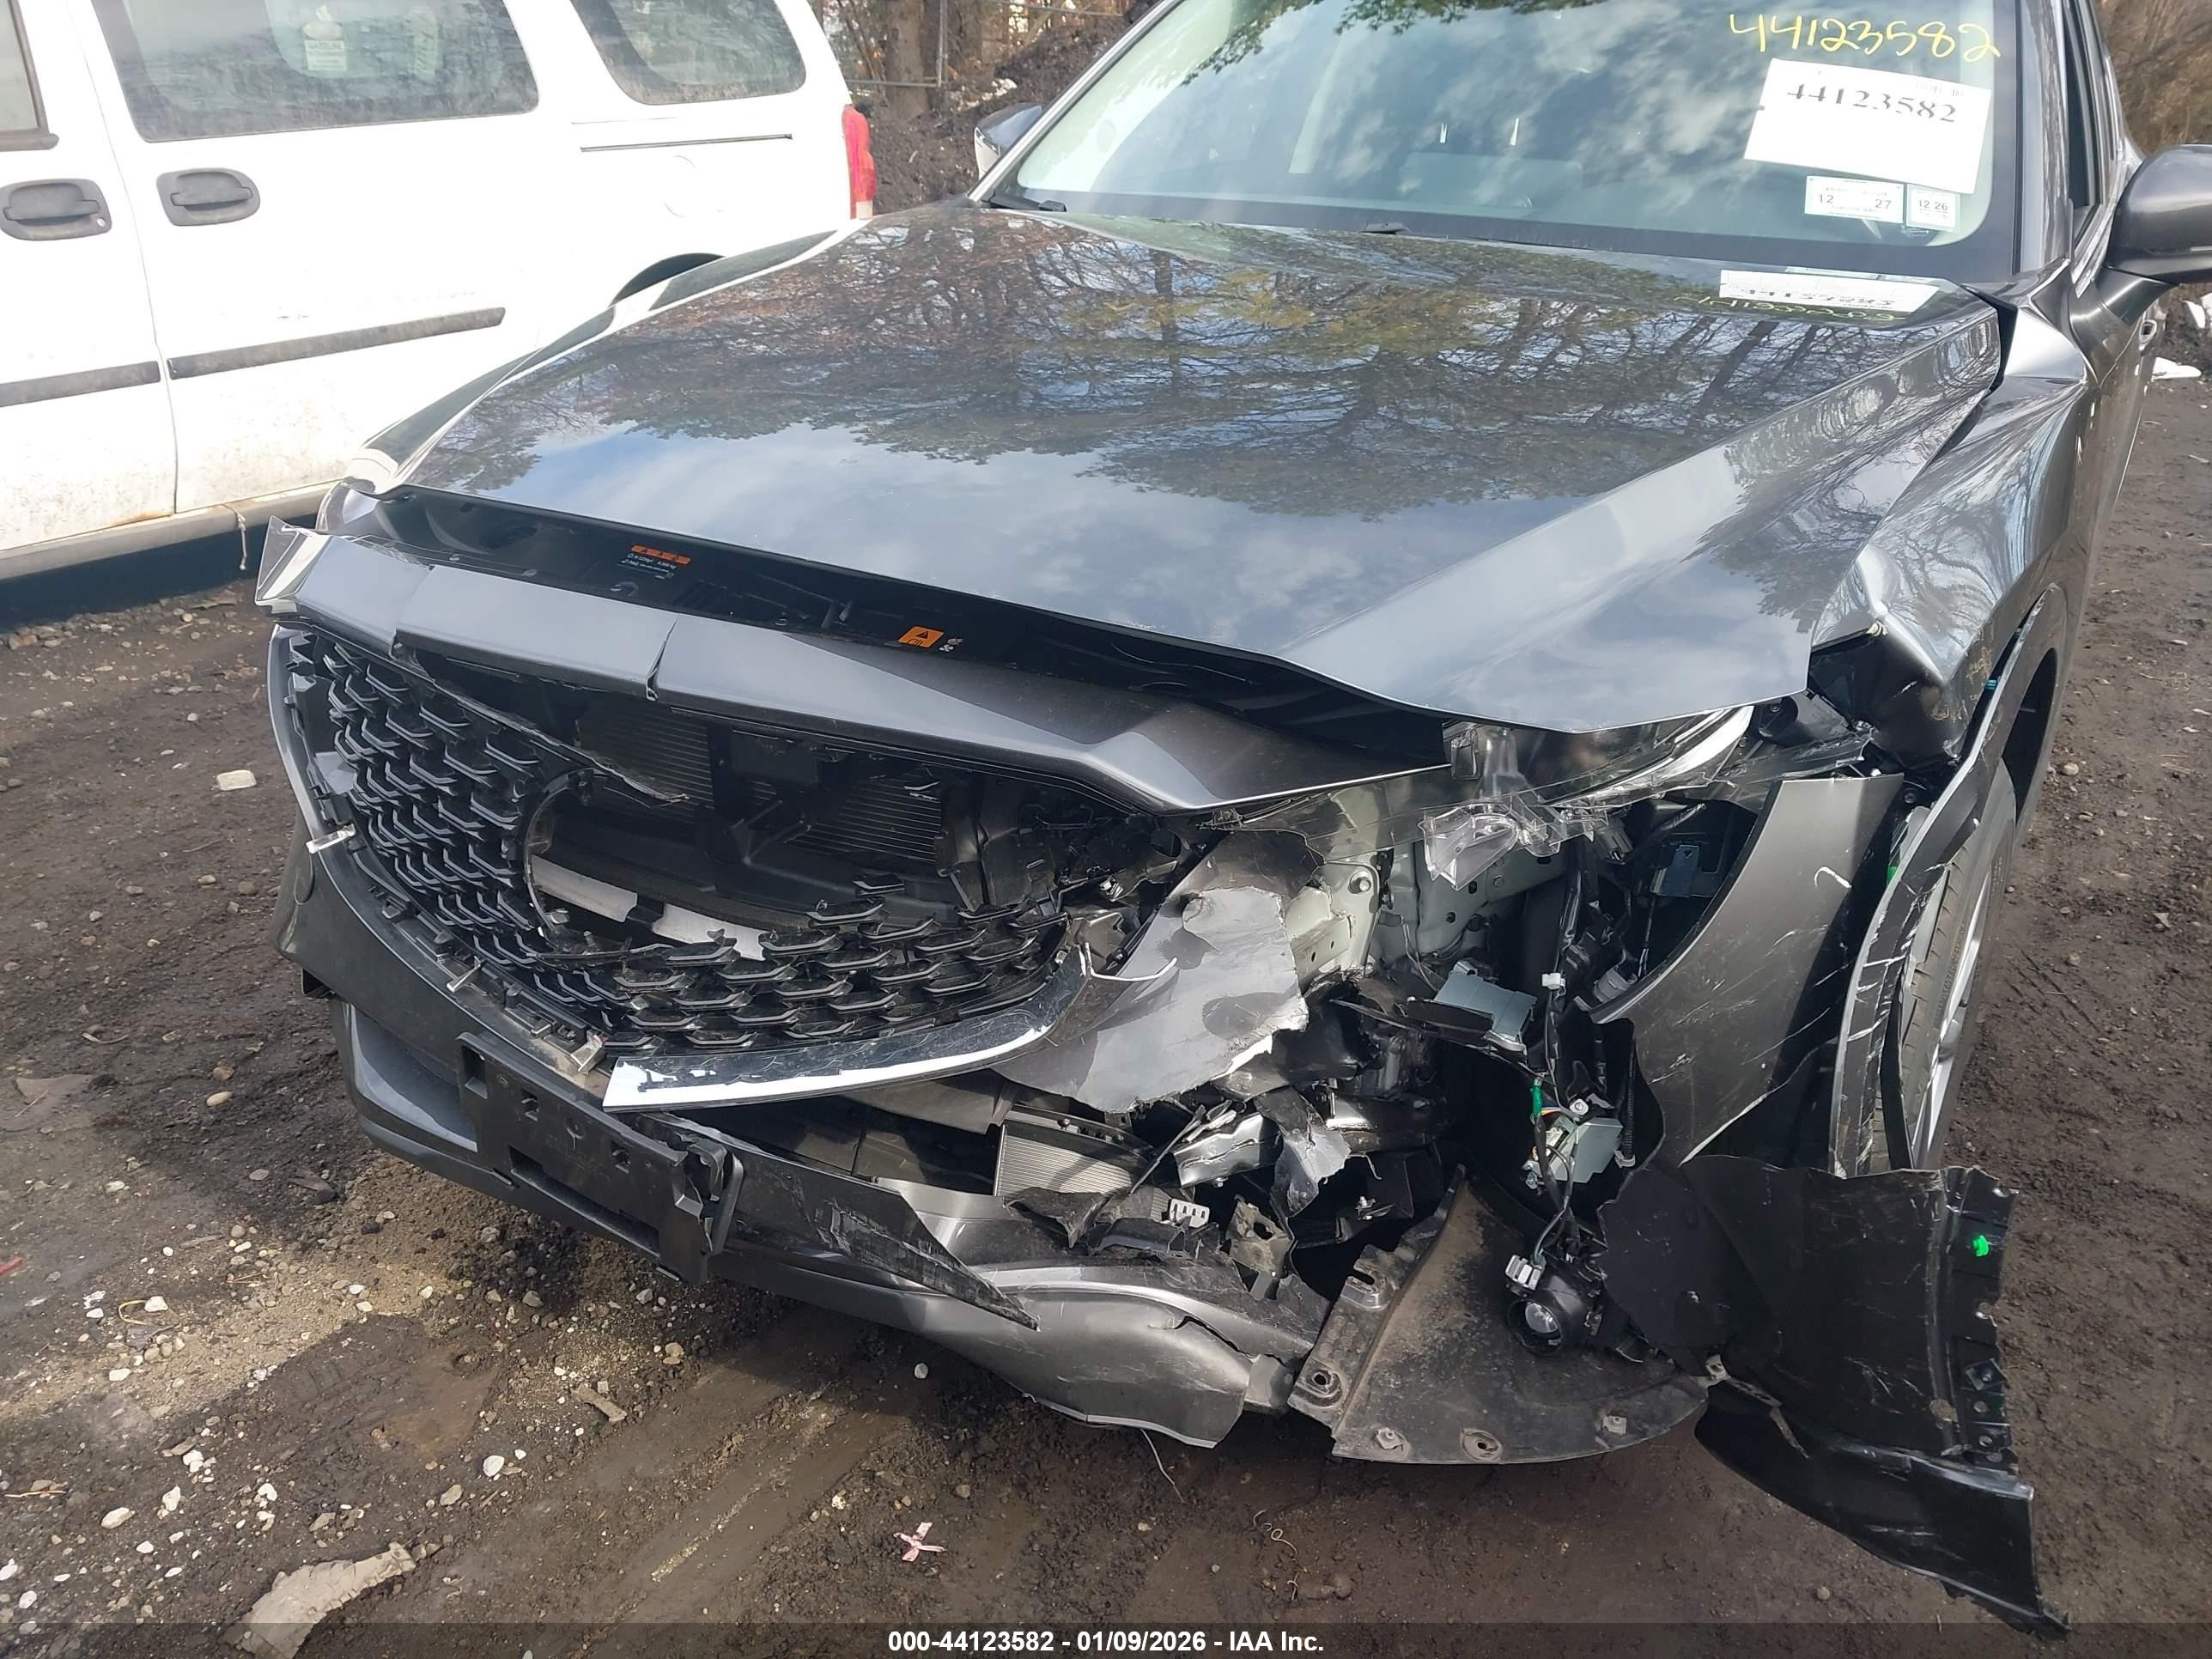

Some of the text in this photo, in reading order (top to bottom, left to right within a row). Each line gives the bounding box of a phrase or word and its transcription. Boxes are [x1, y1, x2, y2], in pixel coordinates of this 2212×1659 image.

[1729, 13, 2002, 63] 44123582
[1786, 82, 1958, 124] 44123582
[1819, 193, 1834, 204] 12
[1875, 198, 1893, 210] 27
[1918, 199, 1949, 211] 12 26
